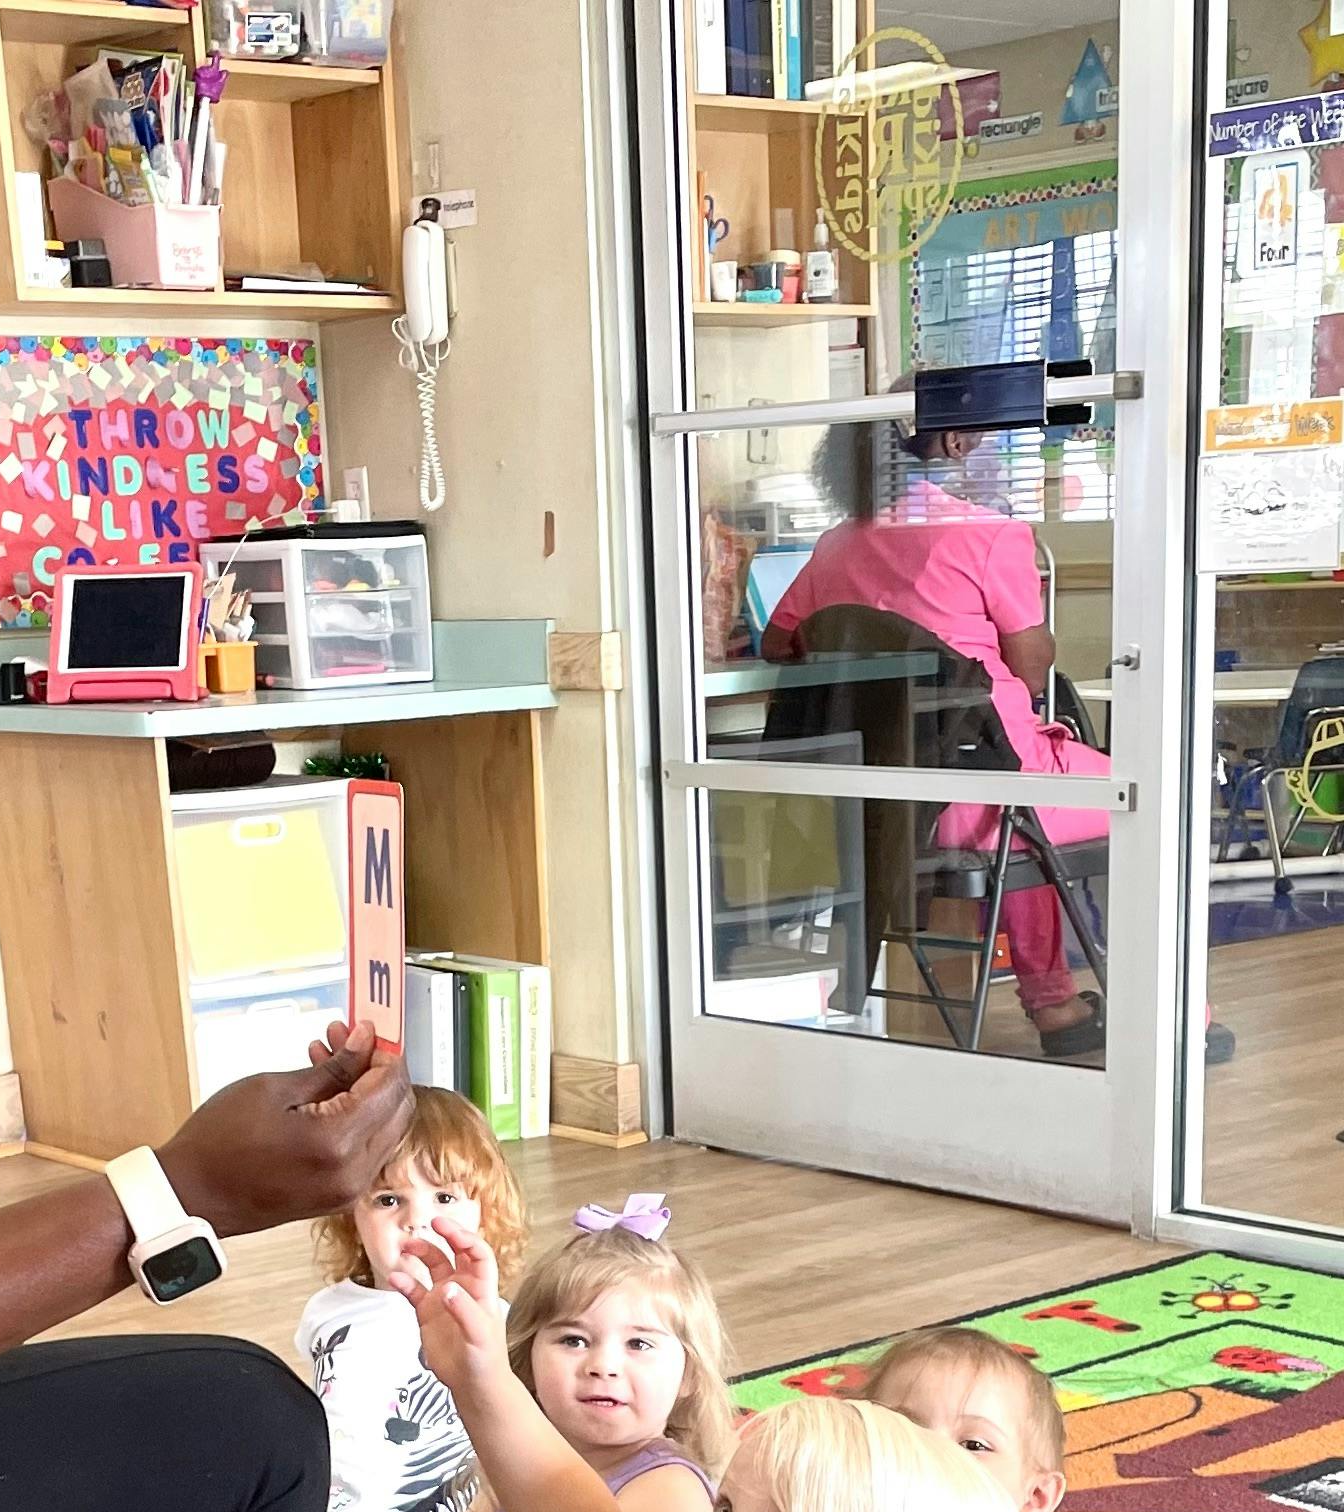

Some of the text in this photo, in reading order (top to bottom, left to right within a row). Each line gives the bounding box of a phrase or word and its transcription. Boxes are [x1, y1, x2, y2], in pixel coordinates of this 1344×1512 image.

[1226, 79, 1269, 103] quare
[981, 115, 1041, 139] rectangle
[1209, 119, 1259, 142] Number
[1263, 113, 1279, 135] of
[983, 203, 1118, 246] ART WO
[68, 408, 230, 450] THROW
[101, 499, 211, 541] LIKE
[364, 826, 393, 909] M
[369, 958, 391, 1008] m
